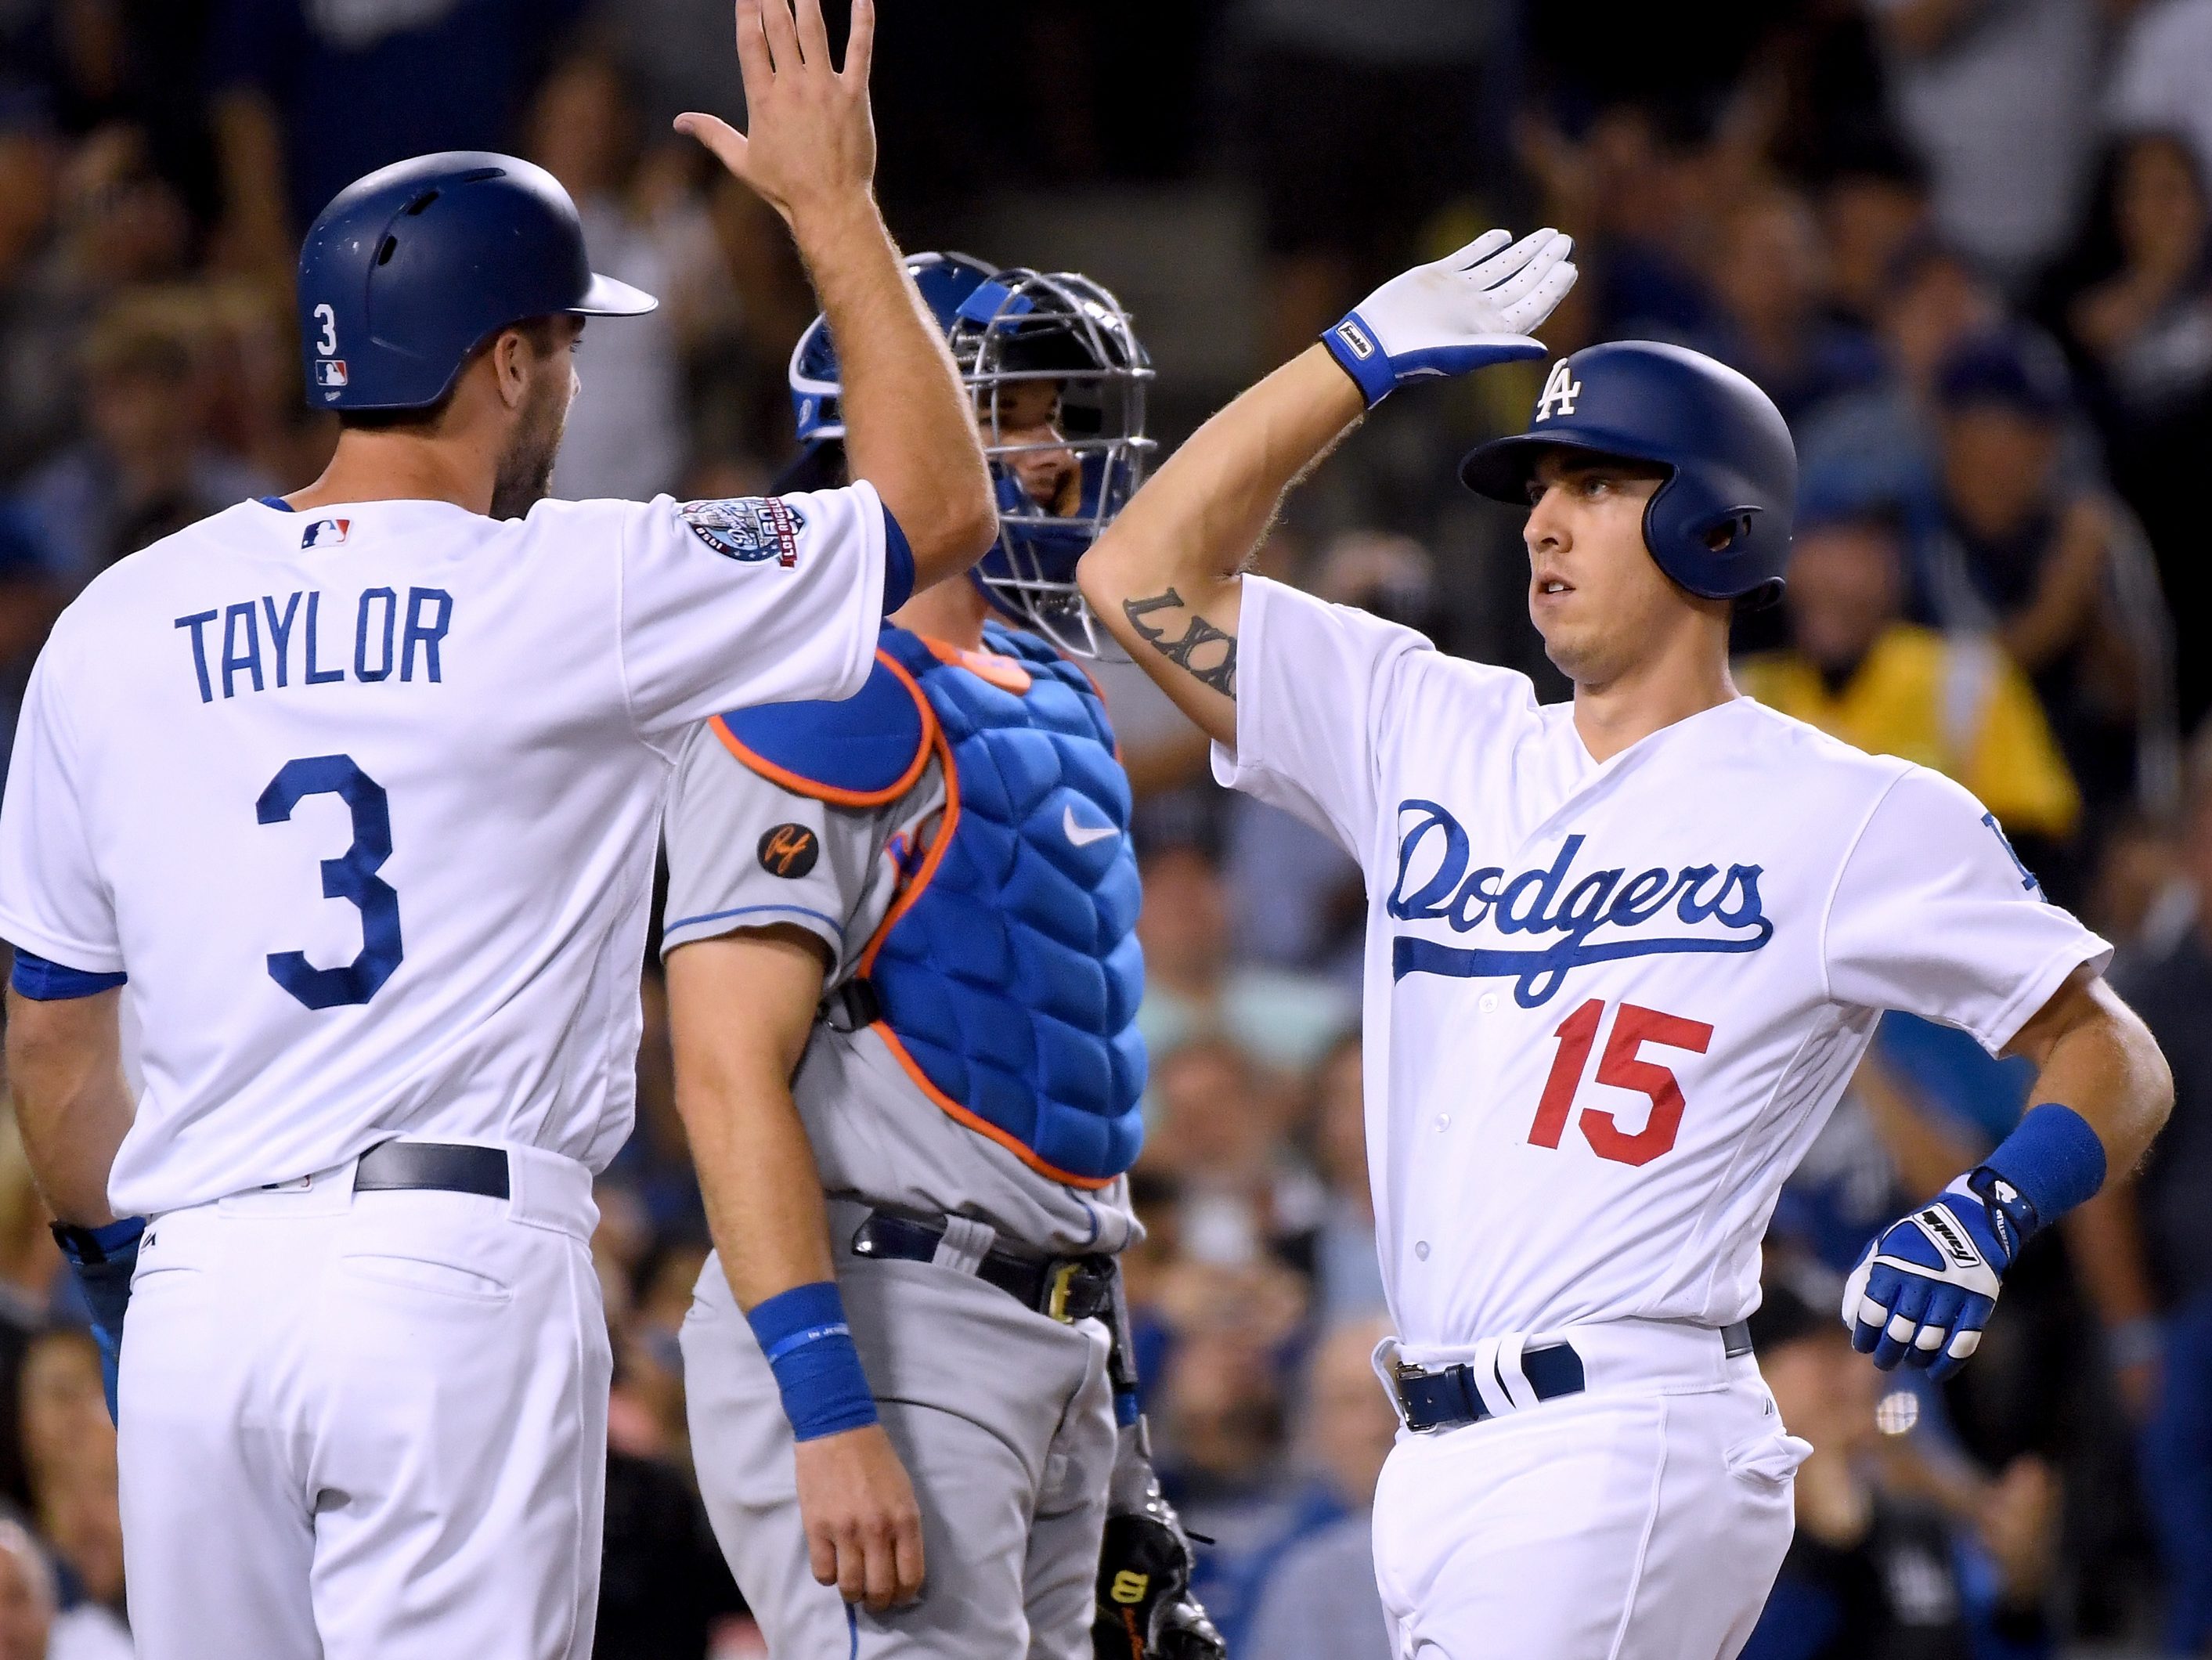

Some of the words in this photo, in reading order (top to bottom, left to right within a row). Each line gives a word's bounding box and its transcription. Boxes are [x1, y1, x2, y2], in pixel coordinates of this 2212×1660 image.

[314, 304, 337, 355] 3
[1536, 358, 1581, 423] LA
[174, 586, 453, 703] TAYLOR
[256, 753, 403, 1010] 3
[1387, 799, 1774, 1009] Dodgers
[1528, 998, 1714, 1167] 15
